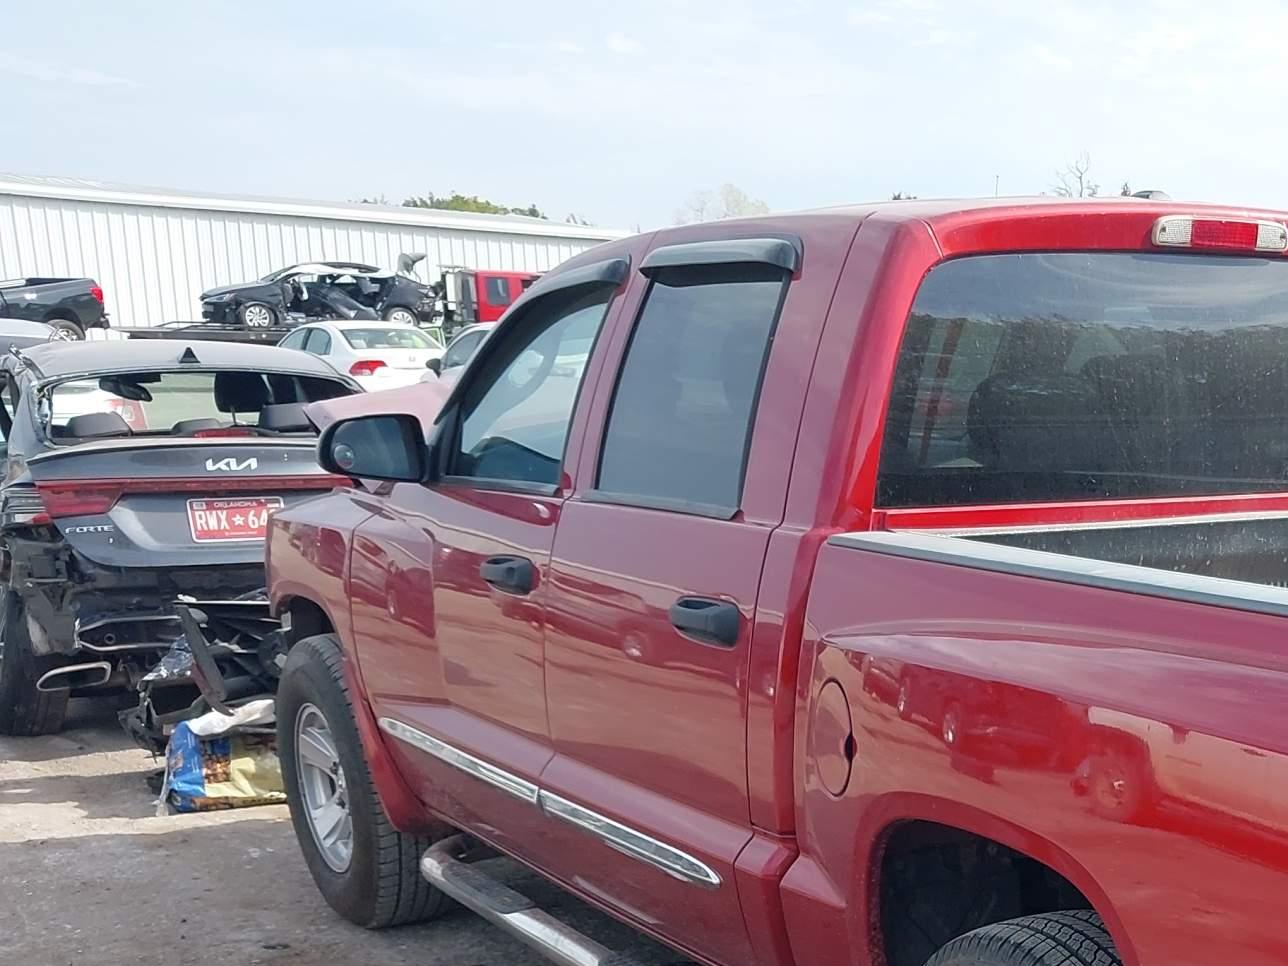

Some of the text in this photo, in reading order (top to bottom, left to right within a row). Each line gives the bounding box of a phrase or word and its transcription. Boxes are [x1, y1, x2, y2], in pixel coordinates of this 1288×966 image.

[194, 508, 277, 531] RWX 64
[65, 524, 115, 535] FORTE
